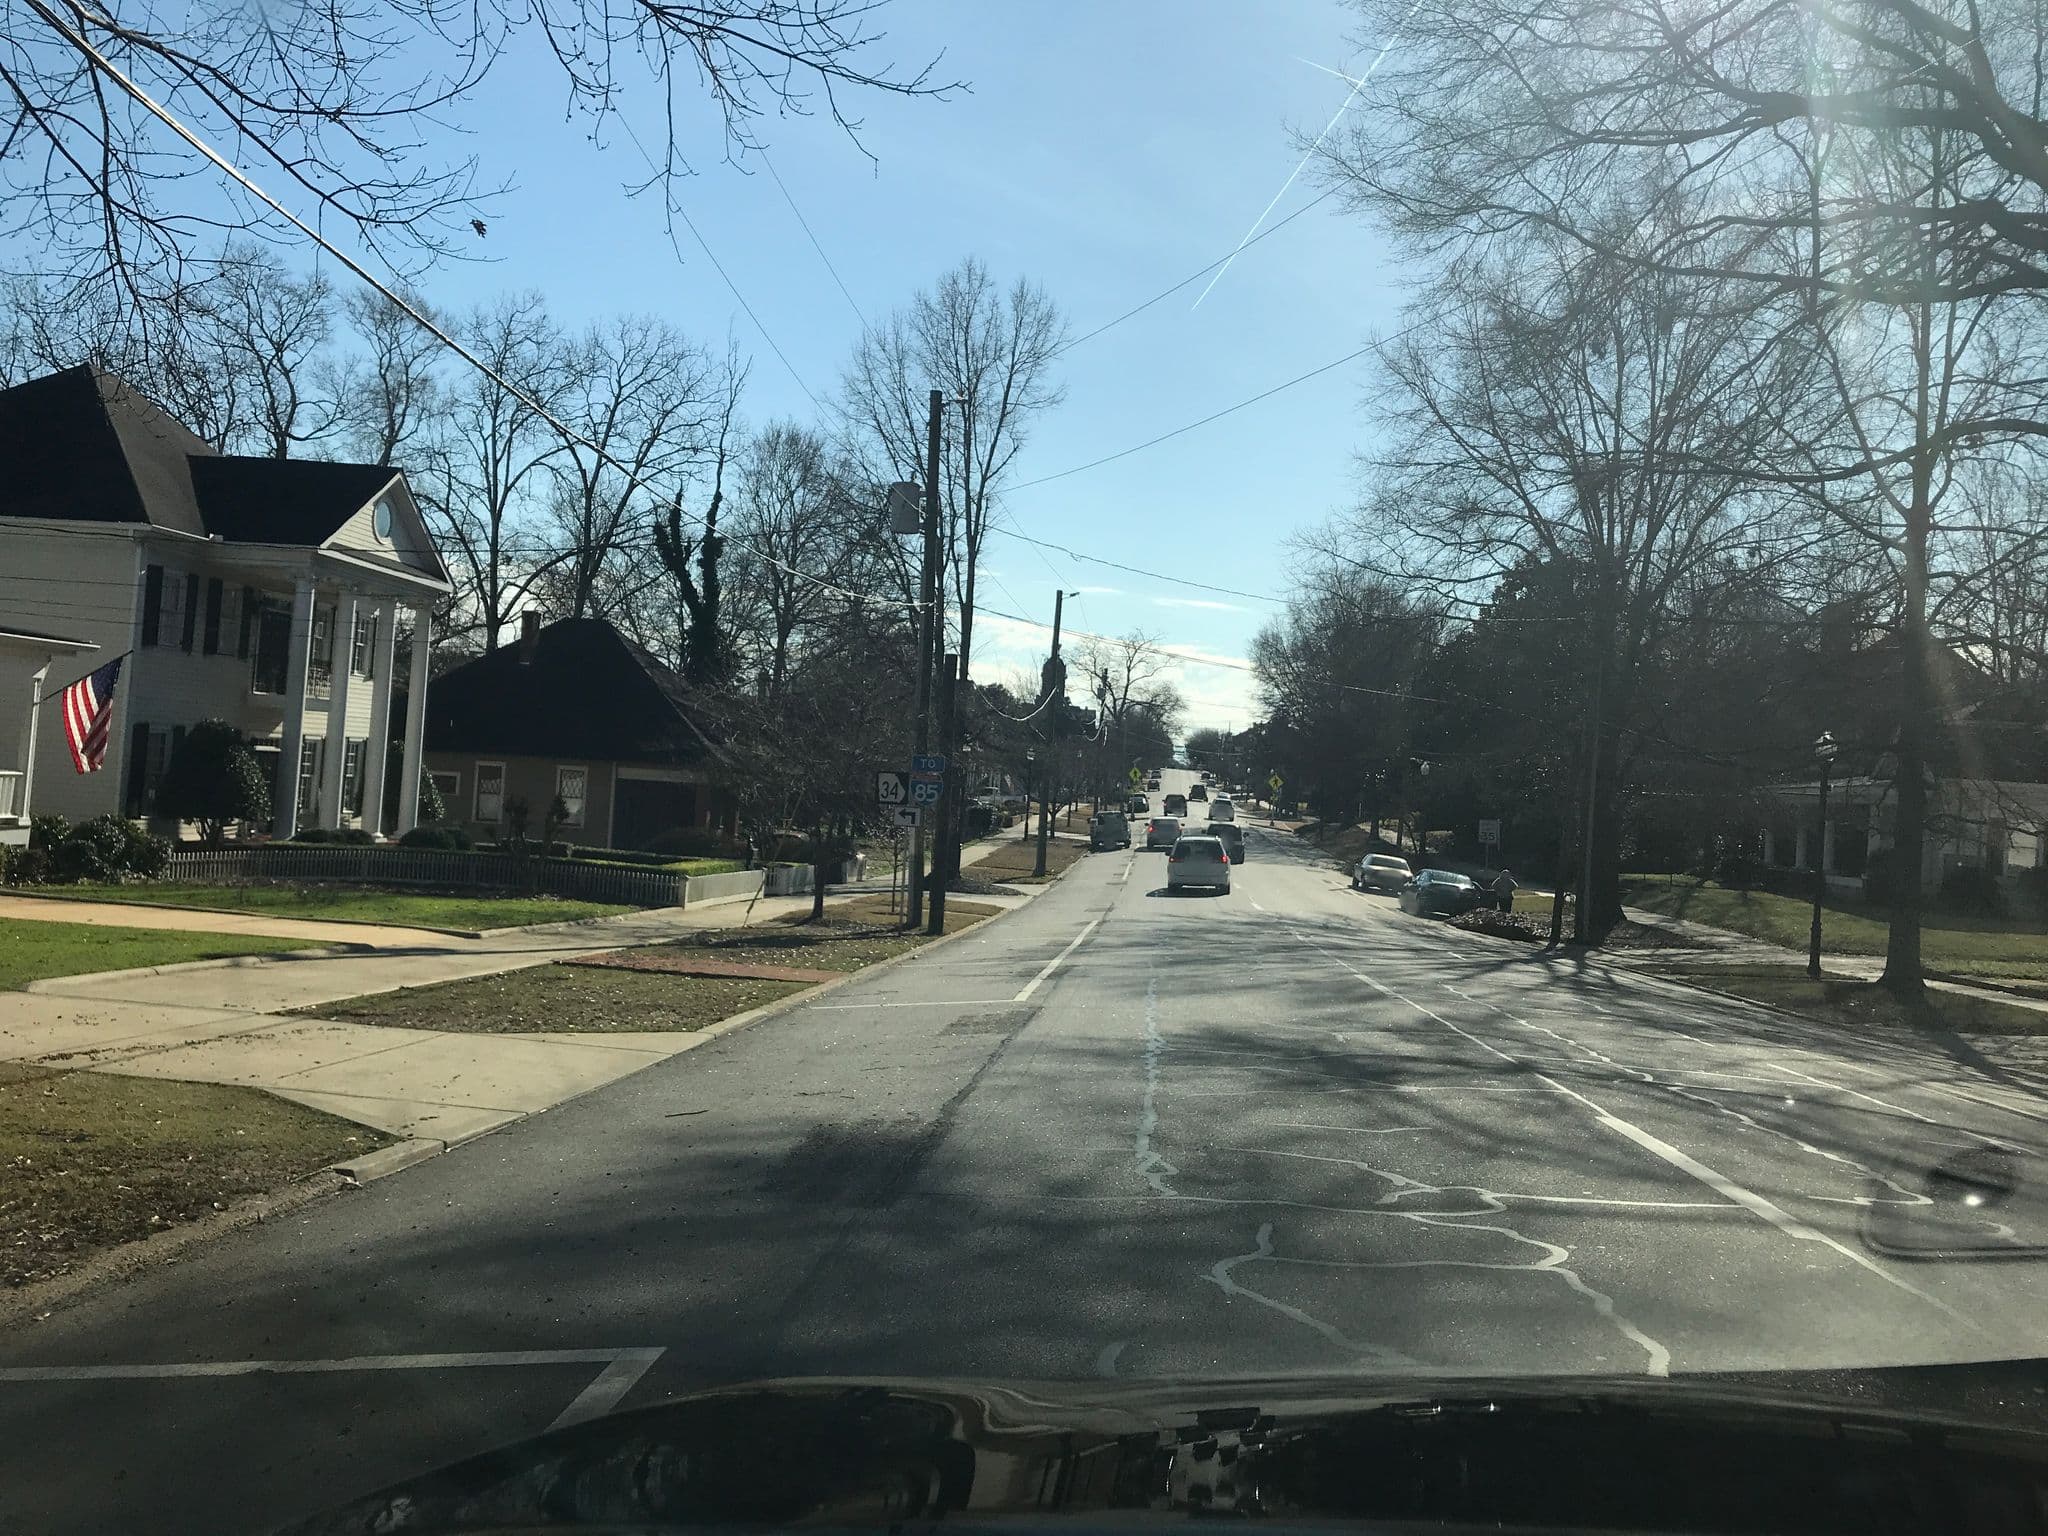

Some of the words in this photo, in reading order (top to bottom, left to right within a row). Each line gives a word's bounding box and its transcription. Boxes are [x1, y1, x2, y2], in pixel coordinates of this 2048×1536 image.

[920, 759, 936, 769] TO
[880, 781, 899, 800] 34
[914, 784, 938, 802] 85
